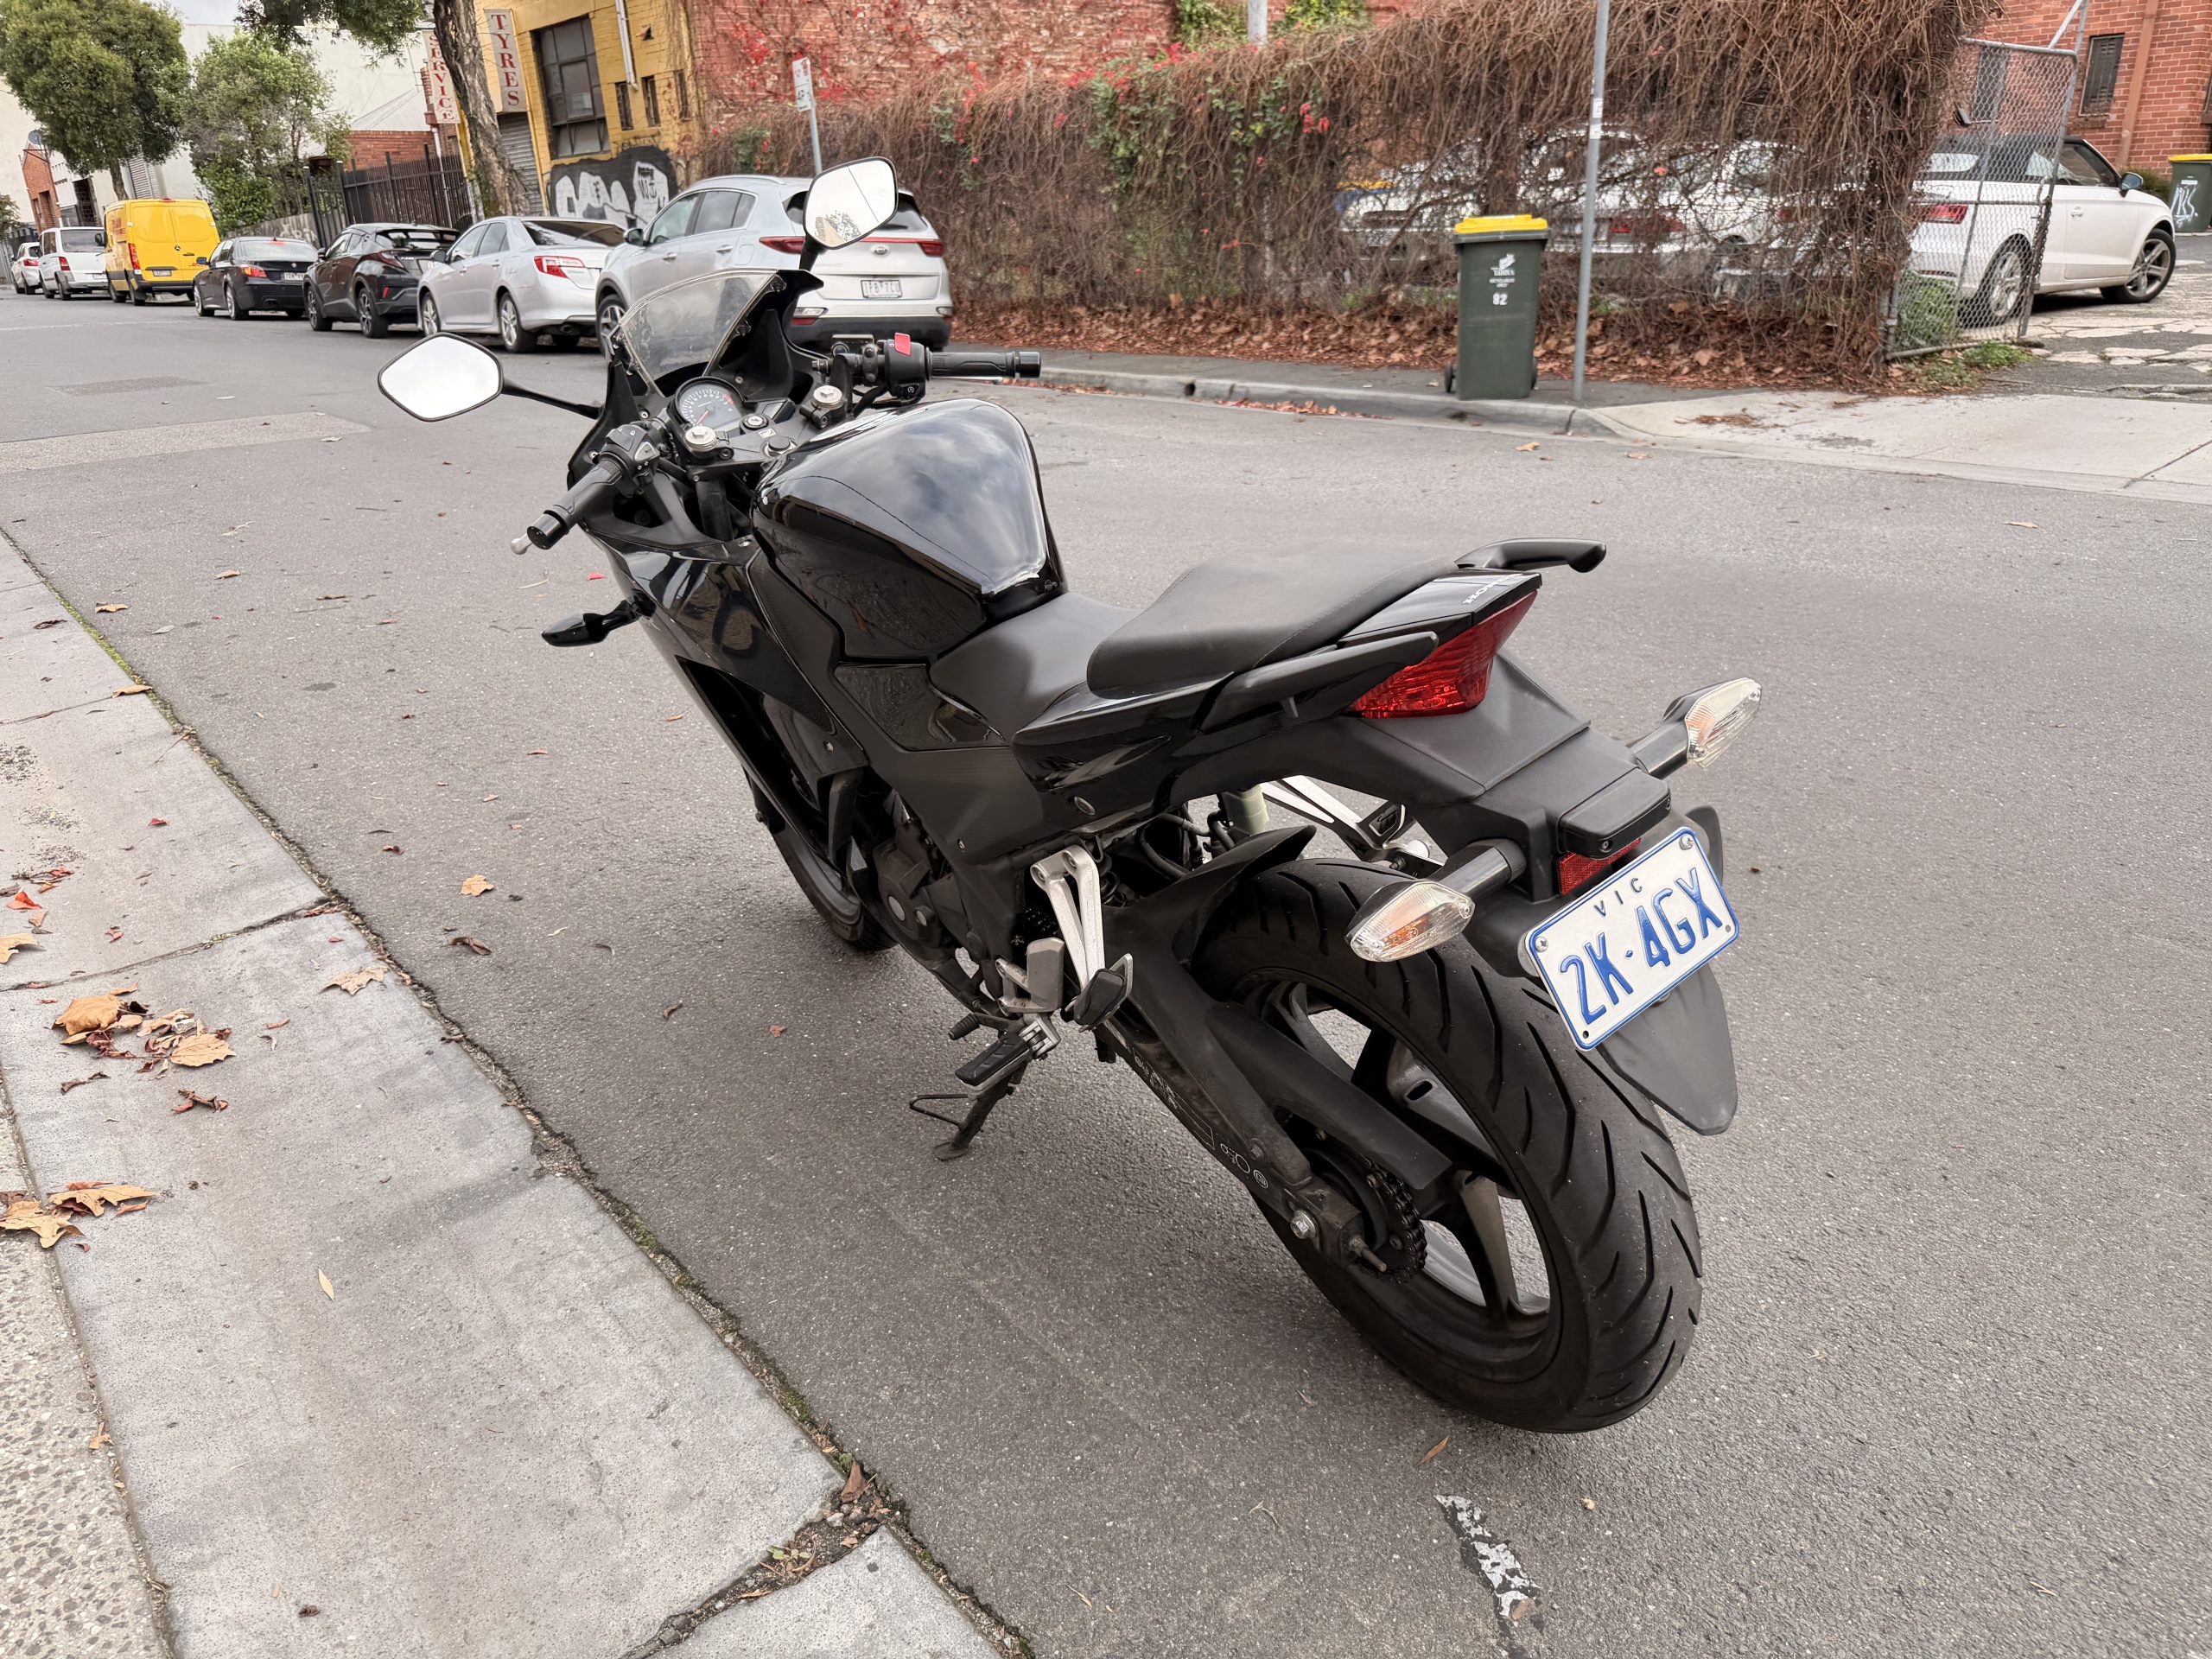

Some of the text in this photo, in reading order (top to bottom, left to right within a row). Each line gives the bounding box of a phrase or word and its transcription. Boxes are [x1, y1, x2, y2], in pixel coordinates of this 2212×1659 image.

[429, 35, 454, 120] SERVICE
[490, 14, 519, 105] TYRES
[1492, 292, 1508, 305] 82
[1593, 877, 1643, 917] VIC
